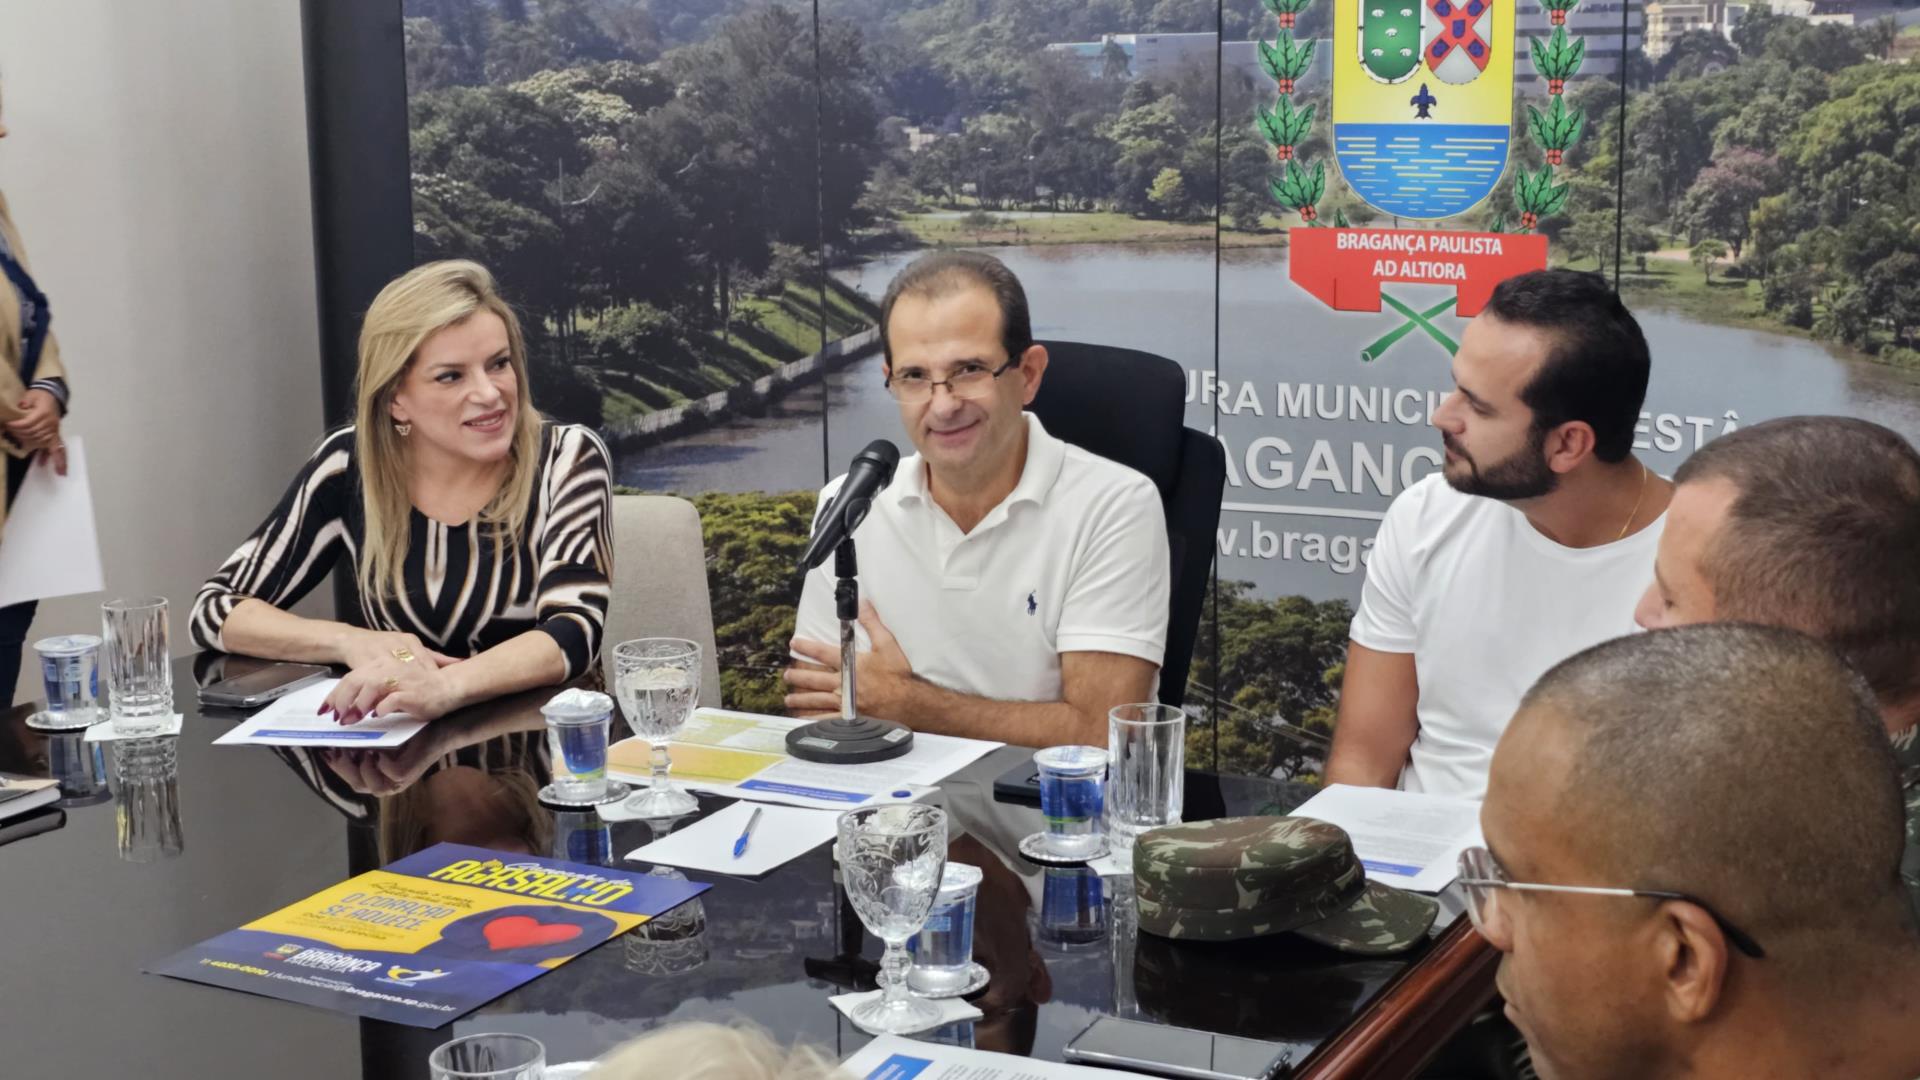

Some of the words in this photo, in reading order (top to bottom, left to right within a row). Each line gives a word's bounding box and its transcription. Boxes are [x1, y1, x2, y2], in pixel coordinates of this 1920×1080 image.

[1336, 233, 1427, 255] BRAGANÇA
[1430, 236, 1503, 255] PAULISTA
[1372, 260, 1397, 276] AD
[1400, 261, 1467, 280] ALTIORA
[428, 860, 634, 906] AGASALHO
[291, 949, 382, 973] BRAGANÇA
